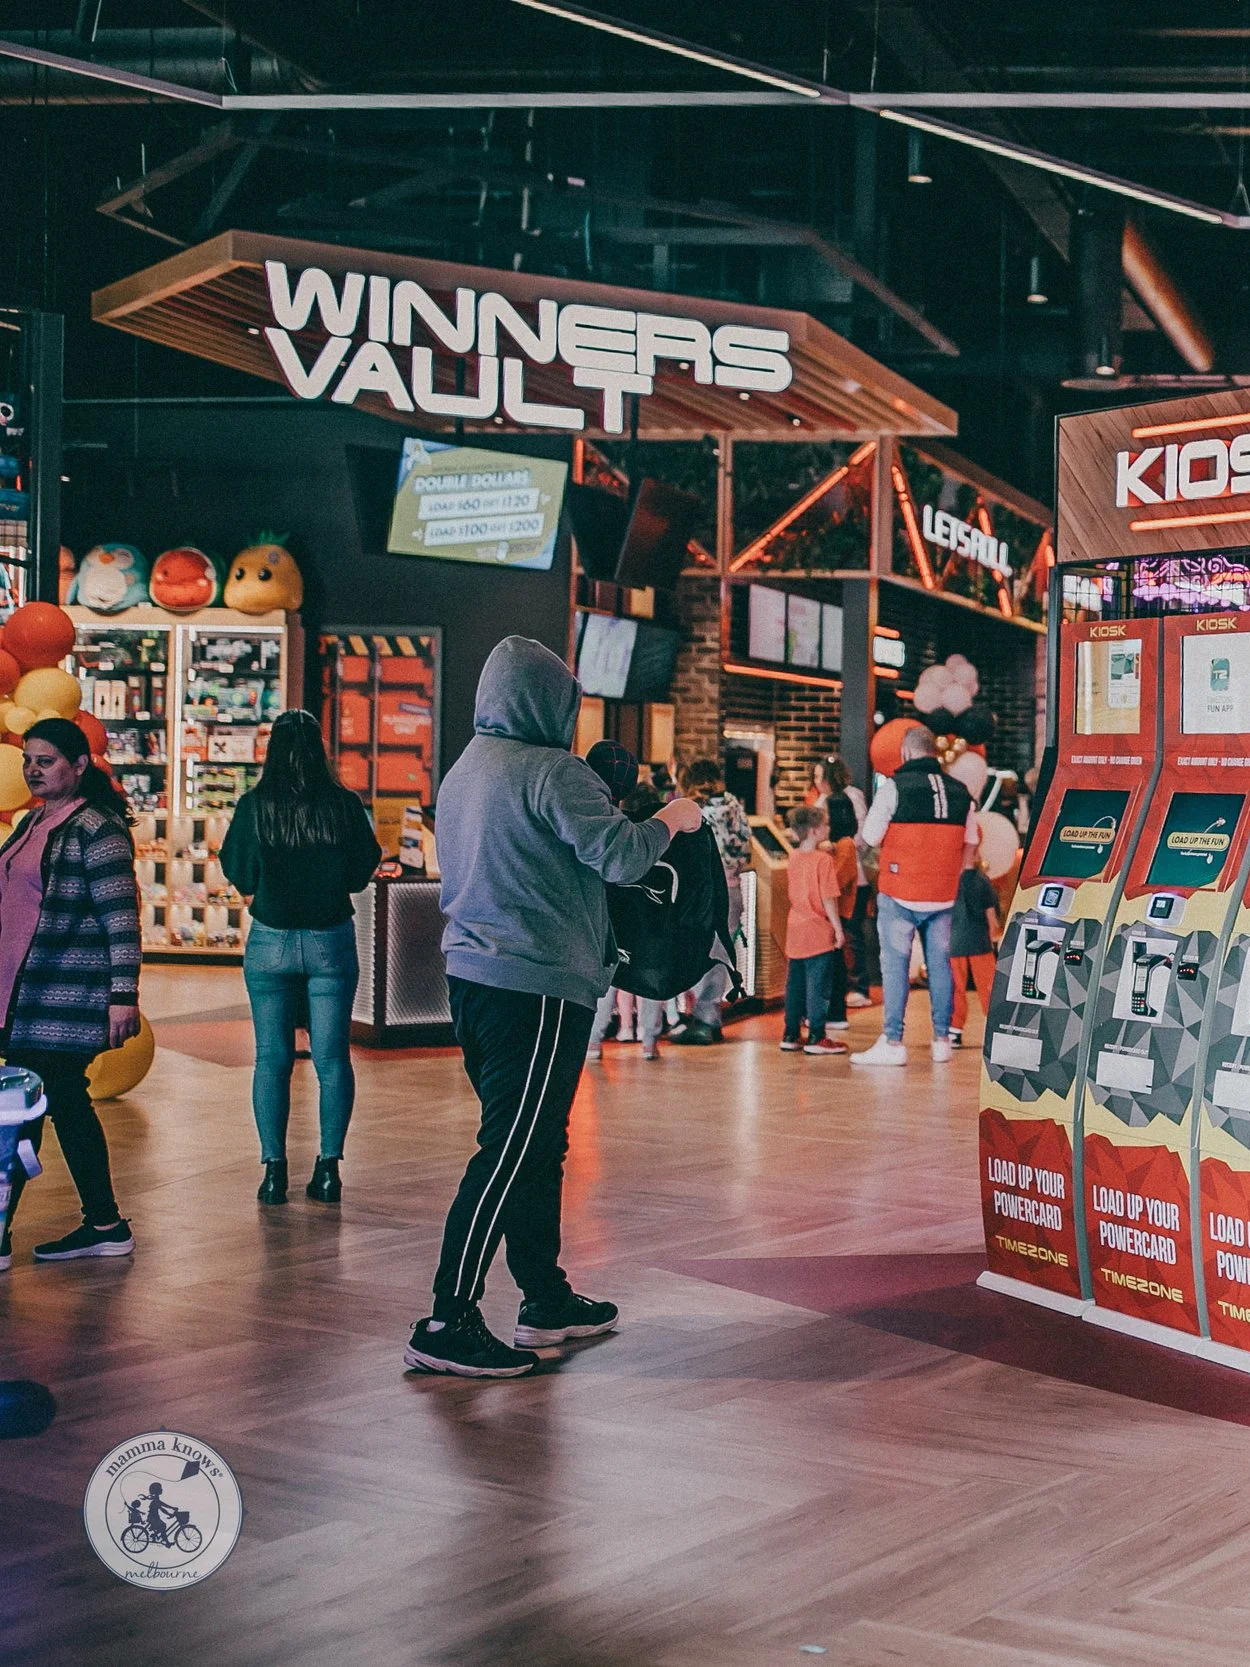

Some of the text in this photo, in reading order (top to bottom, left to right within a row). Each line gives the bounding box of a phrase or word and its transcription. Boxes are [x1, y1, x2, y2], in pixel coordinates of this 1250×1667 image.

[265, 260, 793, 392] WINNERS
[265, 326, 653, 433] VAULT
[414, 475, 469, 493] DOUBLE
[1089, 624, 1127, 638] KIOSK
[1196, 617, 1238, 631] KIOSK
[1207, 704, 1234, 713] FUN APP
[1063, 830, 1078, 838] LOAD
[1171, 836, 1225, 846] LOAD UP THE FUN
[988, 1156, 1065, 1199] LOAD UP YOUR
[994, 1190, 1062, 1231] POWERCARD
[1093, 1184, 1180, 1231] LOAD UP YOUR
[1099, 1220, 1177, 1265] POWERCARD
[1209, 1212, 1244, 1247] LOAD
[995, 1234, 1069, 1268] TIMEZONE
[1100, 1267, 1184, 1304] TIMEZONE
